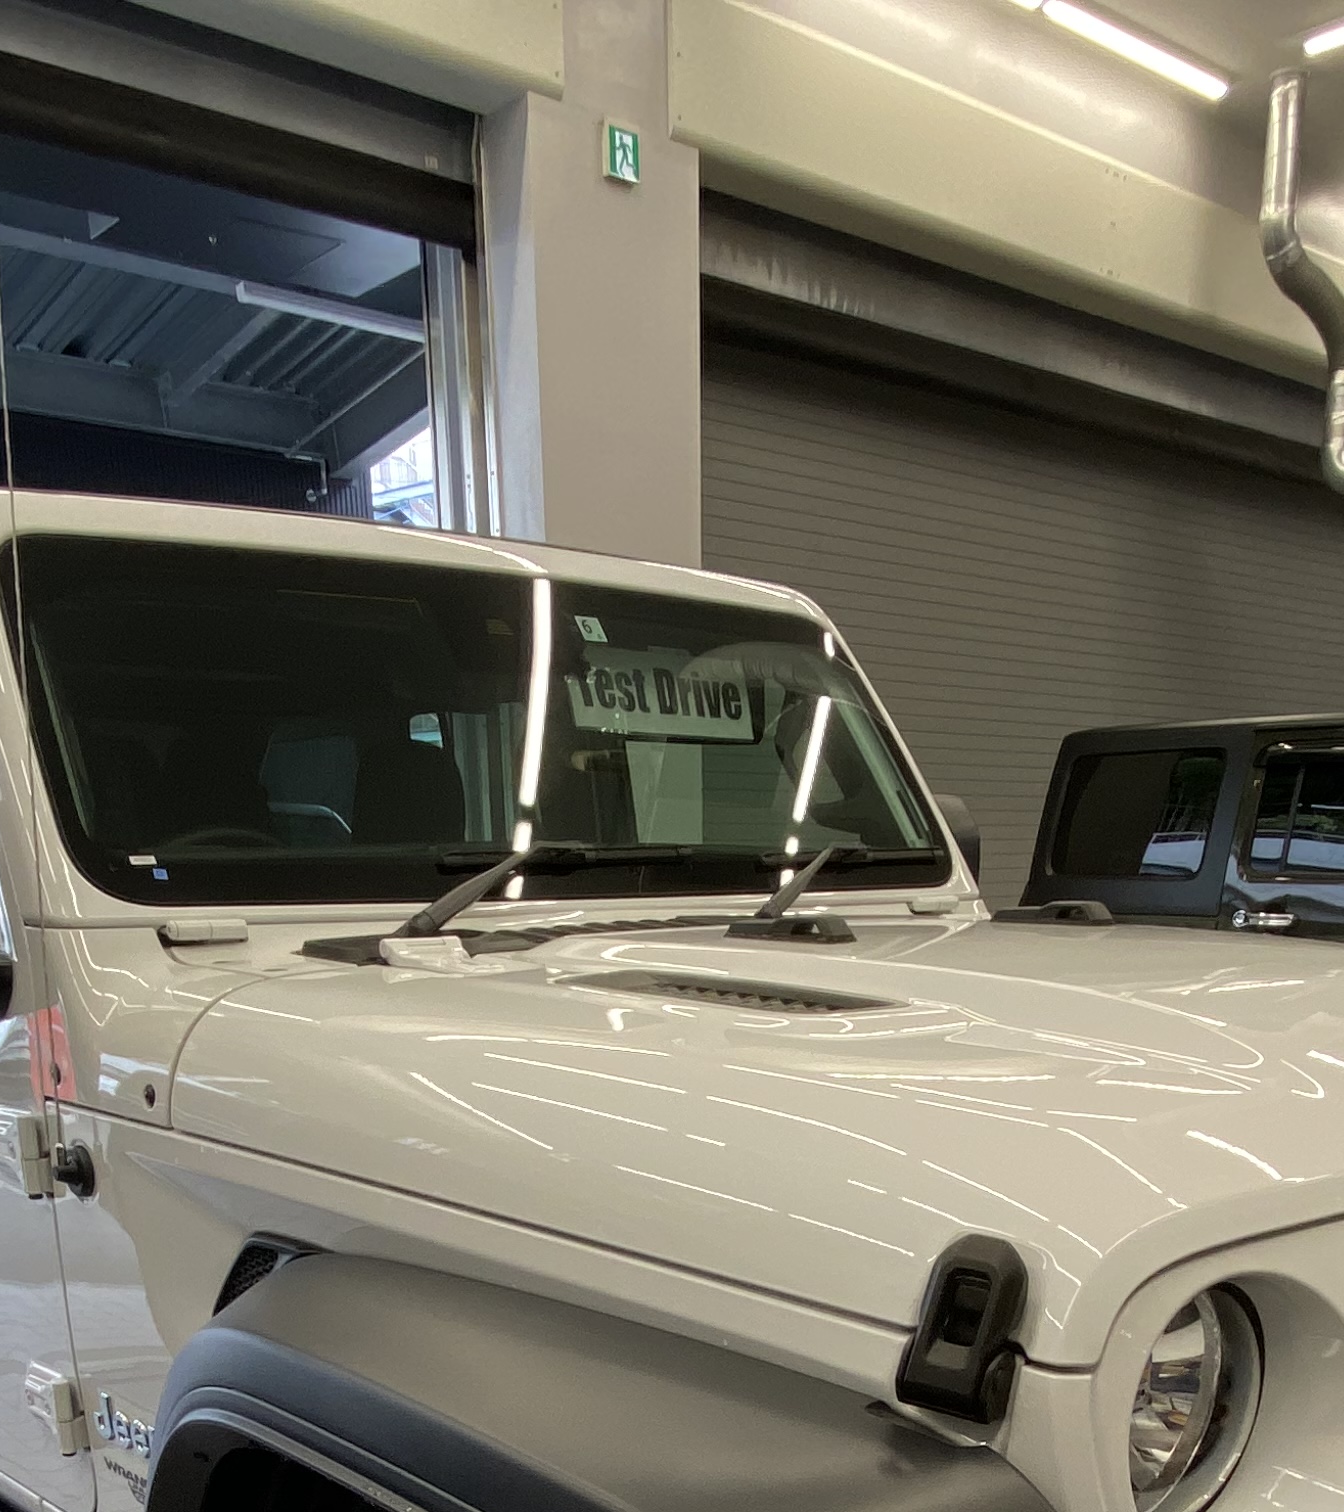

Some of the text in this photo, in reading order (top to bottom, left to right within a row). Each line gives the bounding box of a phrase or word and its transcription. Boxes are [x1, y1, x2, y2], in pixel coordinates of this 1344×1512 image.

[582, 620, 592, 634] 6
[576, 668, 742, 720] Test Drive
[94, 1391, 155, 1459] Jee
